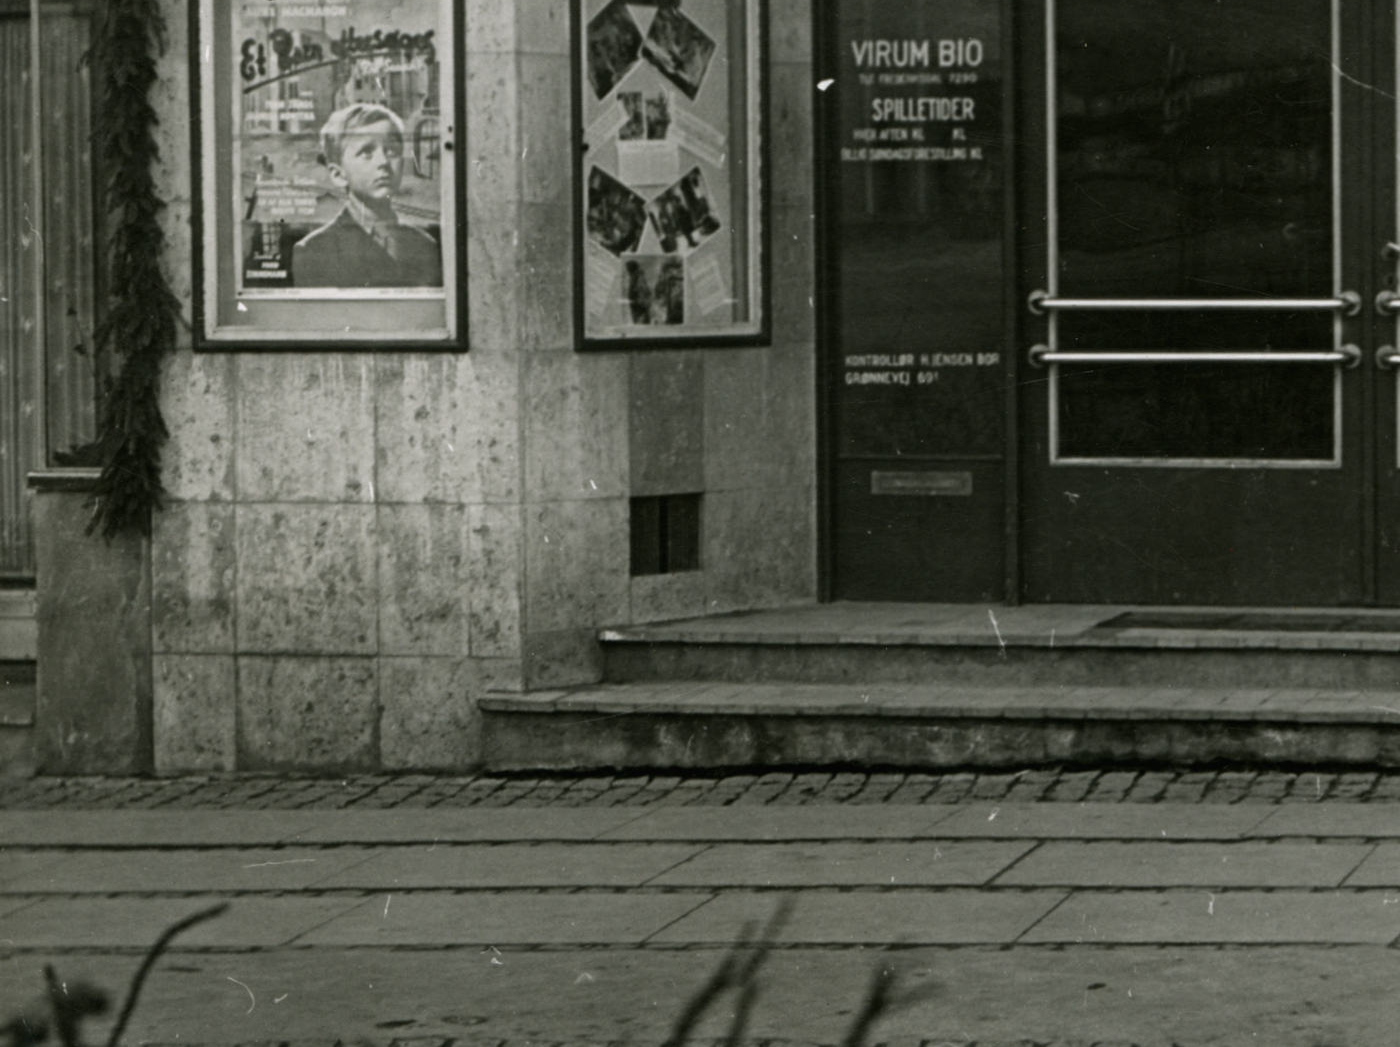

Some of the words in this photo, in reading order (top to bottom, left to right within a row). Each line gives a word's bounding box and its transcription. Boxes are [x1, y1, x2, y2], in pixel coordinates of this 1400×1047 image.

[851, 39, 930, 68] VIRUM
[937, 38, 984, 68] BIO
[872, 97, 976, 121] SPILLETIDER
